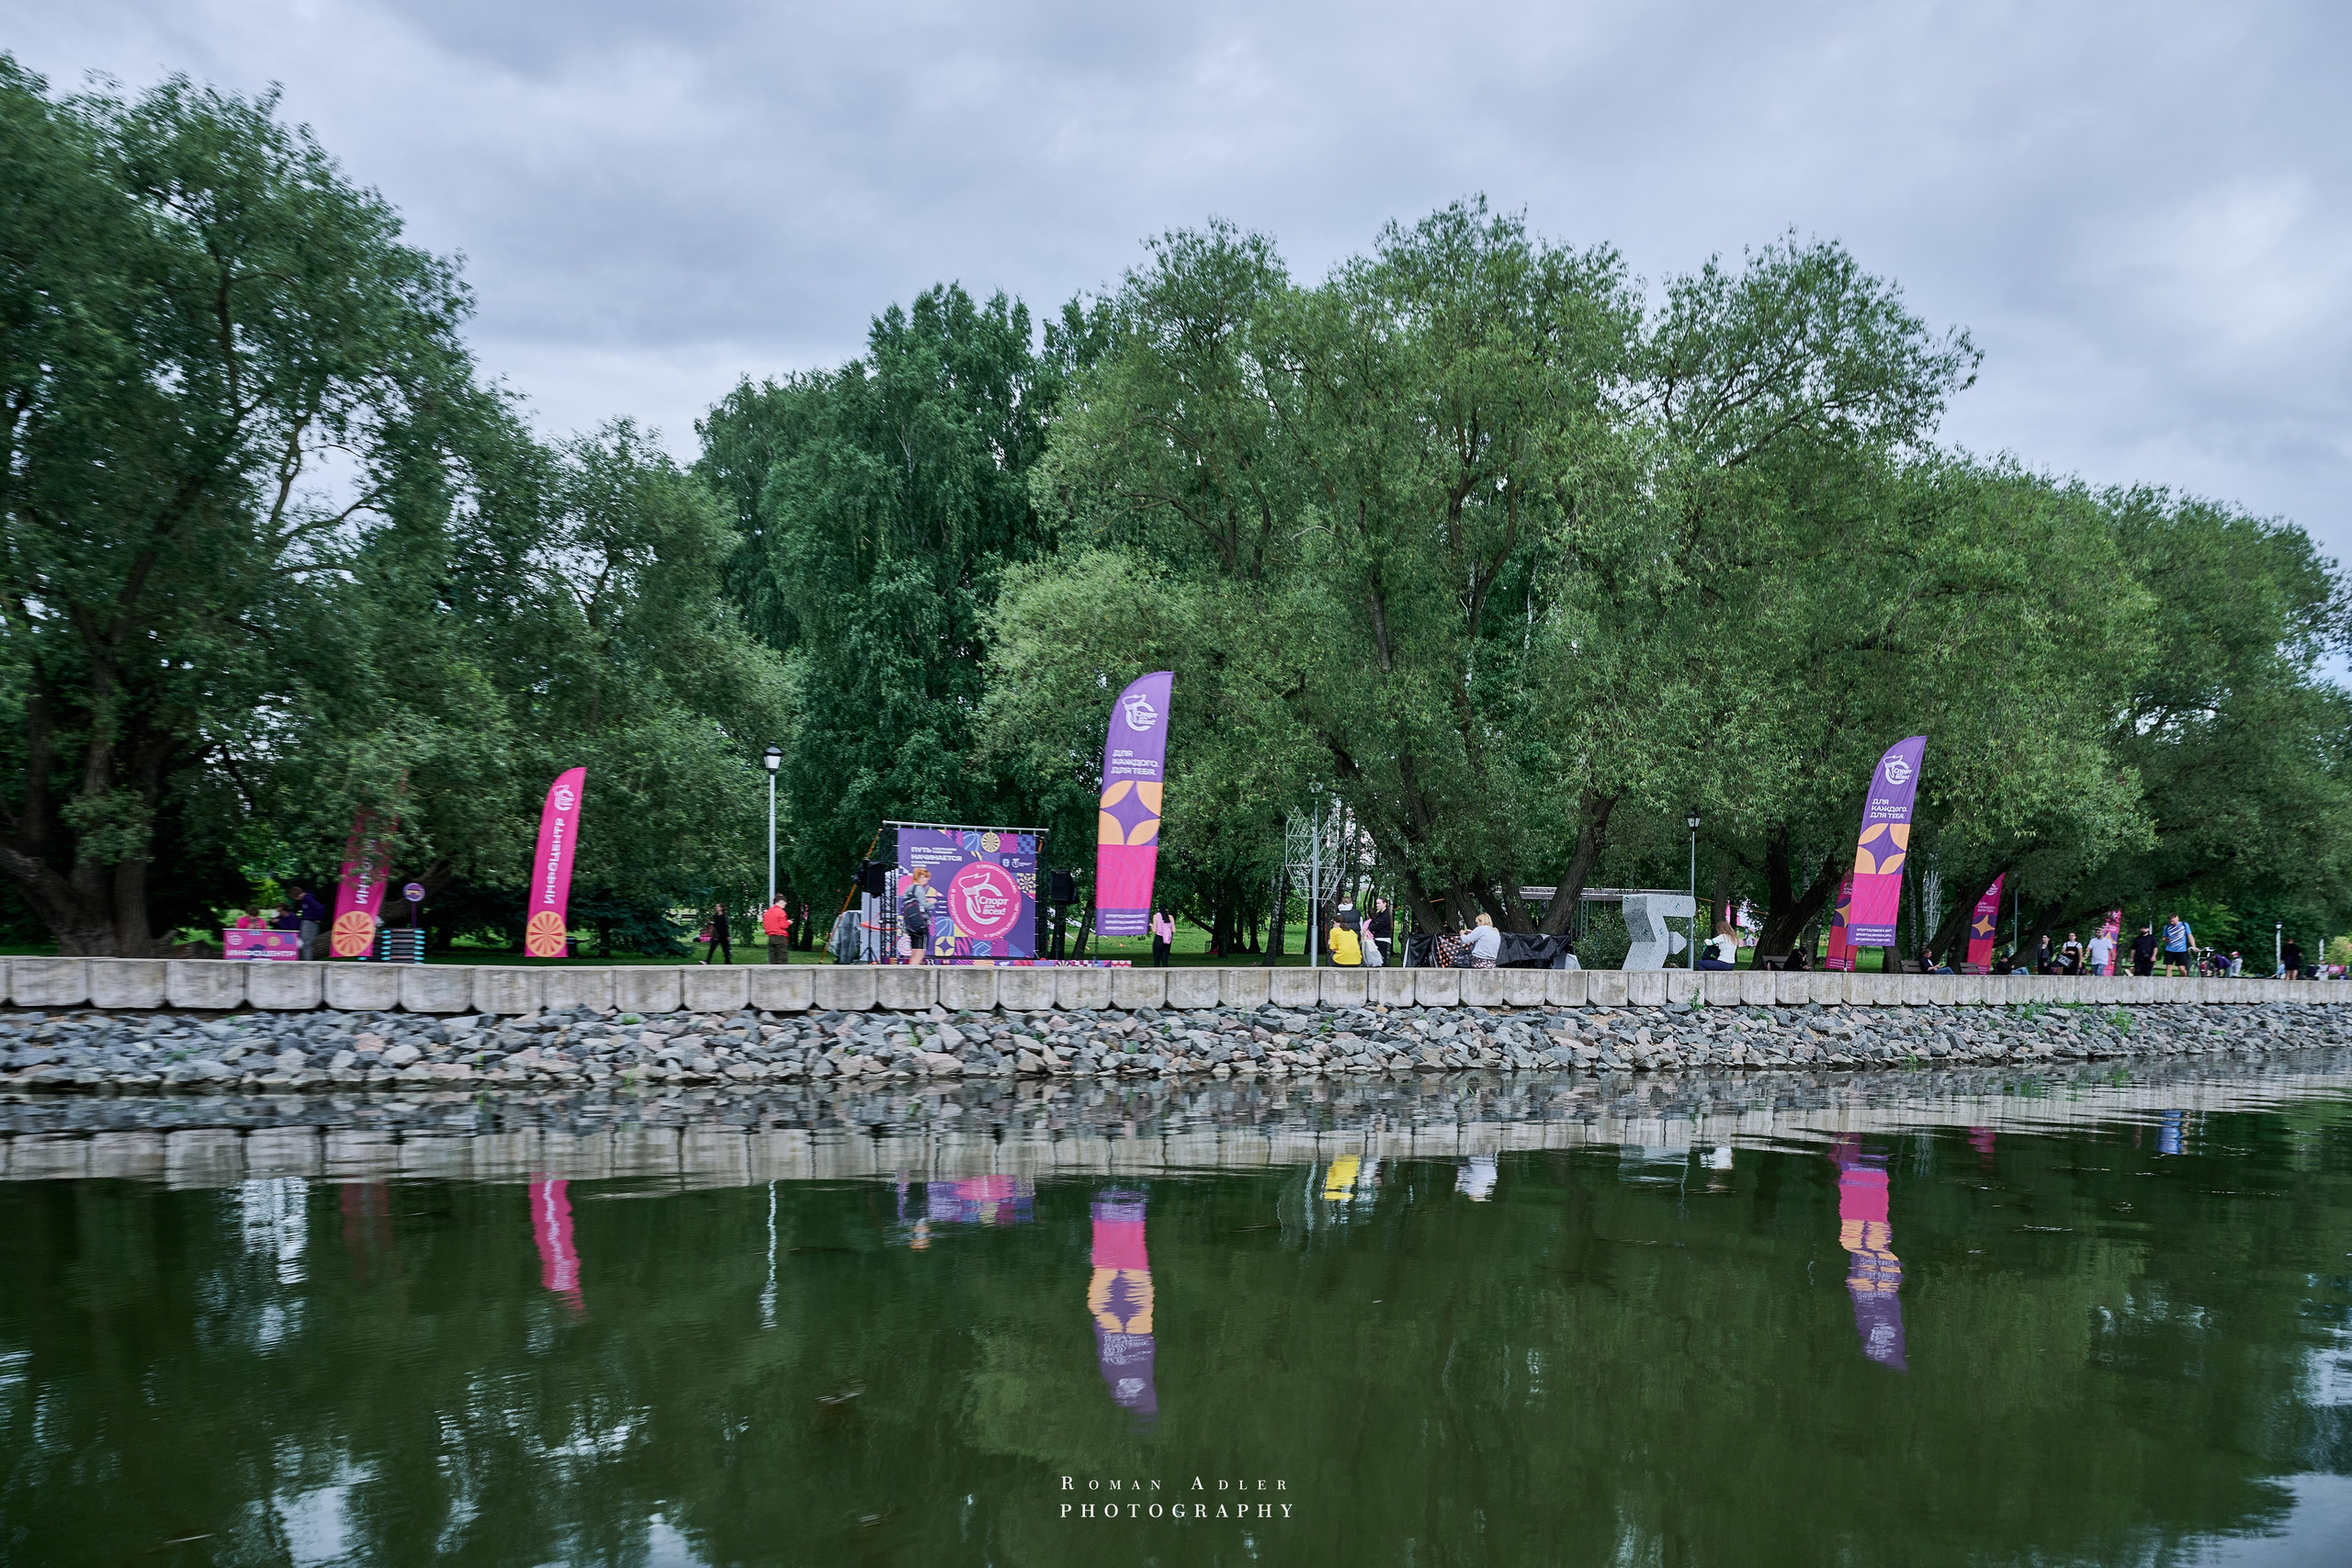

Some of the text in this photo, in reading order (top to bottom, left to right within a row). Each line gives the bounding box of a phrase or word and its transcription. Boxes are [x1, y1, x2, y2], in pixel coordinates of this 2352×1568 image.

[543, 818, 565, 905] ИНФОЦЕНТР
[978, 896, 1010, 907] Спорт
[982, 908, 1006, 916] всех!
